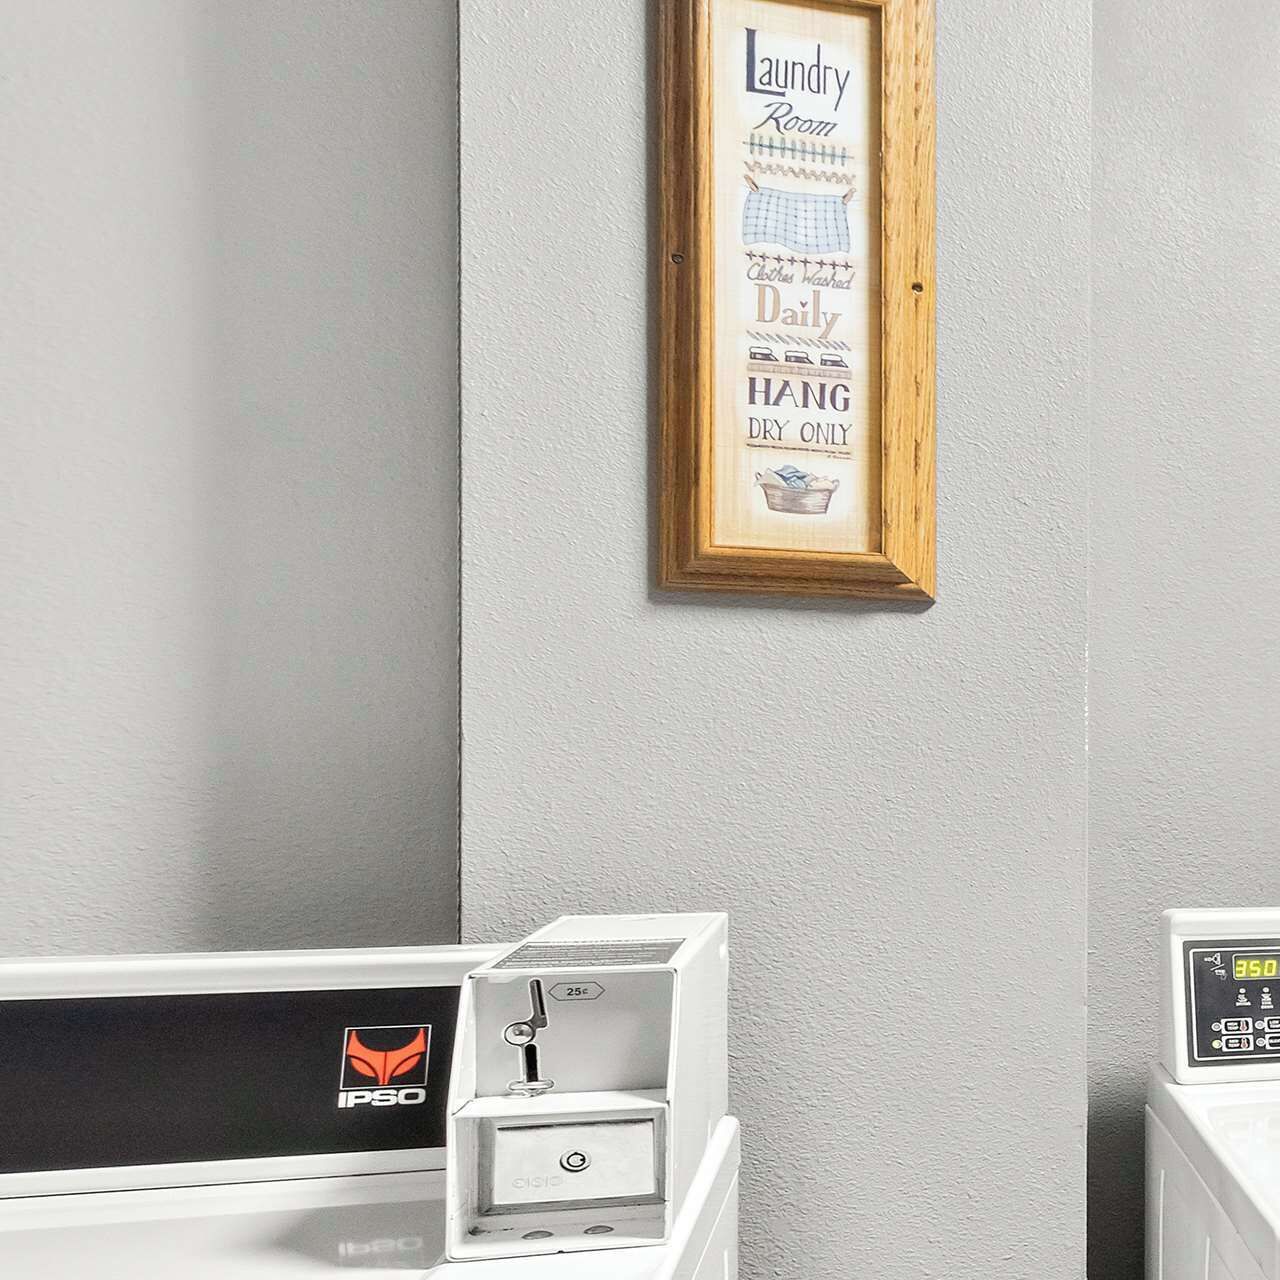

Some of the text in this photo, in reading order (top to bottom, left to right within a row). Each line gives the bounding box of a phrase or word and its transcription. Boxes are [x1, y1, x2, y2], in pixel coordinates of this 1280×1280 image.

[745, 27, 850, 111] Laundry
[753, 102, 839, 137] Room
[746, 262, 856, 290] Clothes Washed
[753, 283, 843, 340] Daily
[747, 376, 851, 413] HANG
[748, 416, 853, 447] DRY ONLY
[1235, 959, 1278, 978] 350
[338, 1087, 427, 1109] IPSO
